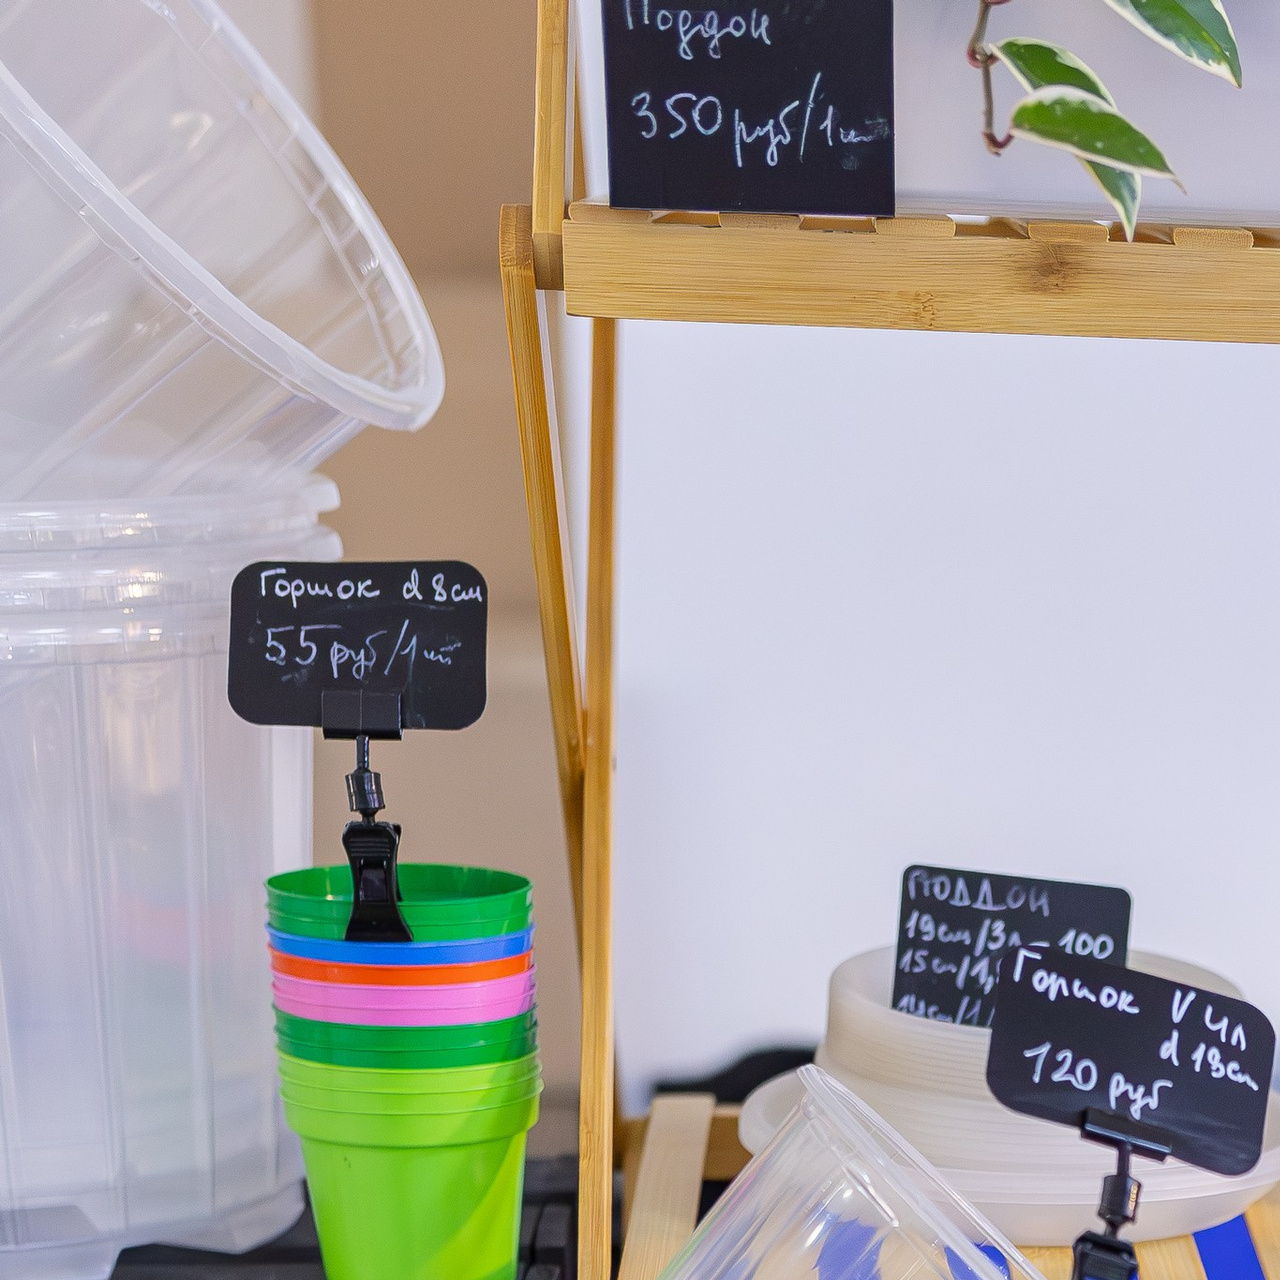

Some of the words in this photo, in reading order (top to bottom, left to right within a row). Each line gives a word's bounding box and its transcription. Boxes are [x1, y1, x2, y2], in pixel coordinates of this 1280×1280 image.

[631, 92, 722, 139] 350
[260, 568, 380, 608] Горшок
[265, 624, 342, 665] 55
[1058, 928, 1114, 959] 100
[1012, 947, 1139, 1014] Горшок
[1023, 1041, 1098, 1091] 120
[1110, 1072, 1173, 1120] руб
